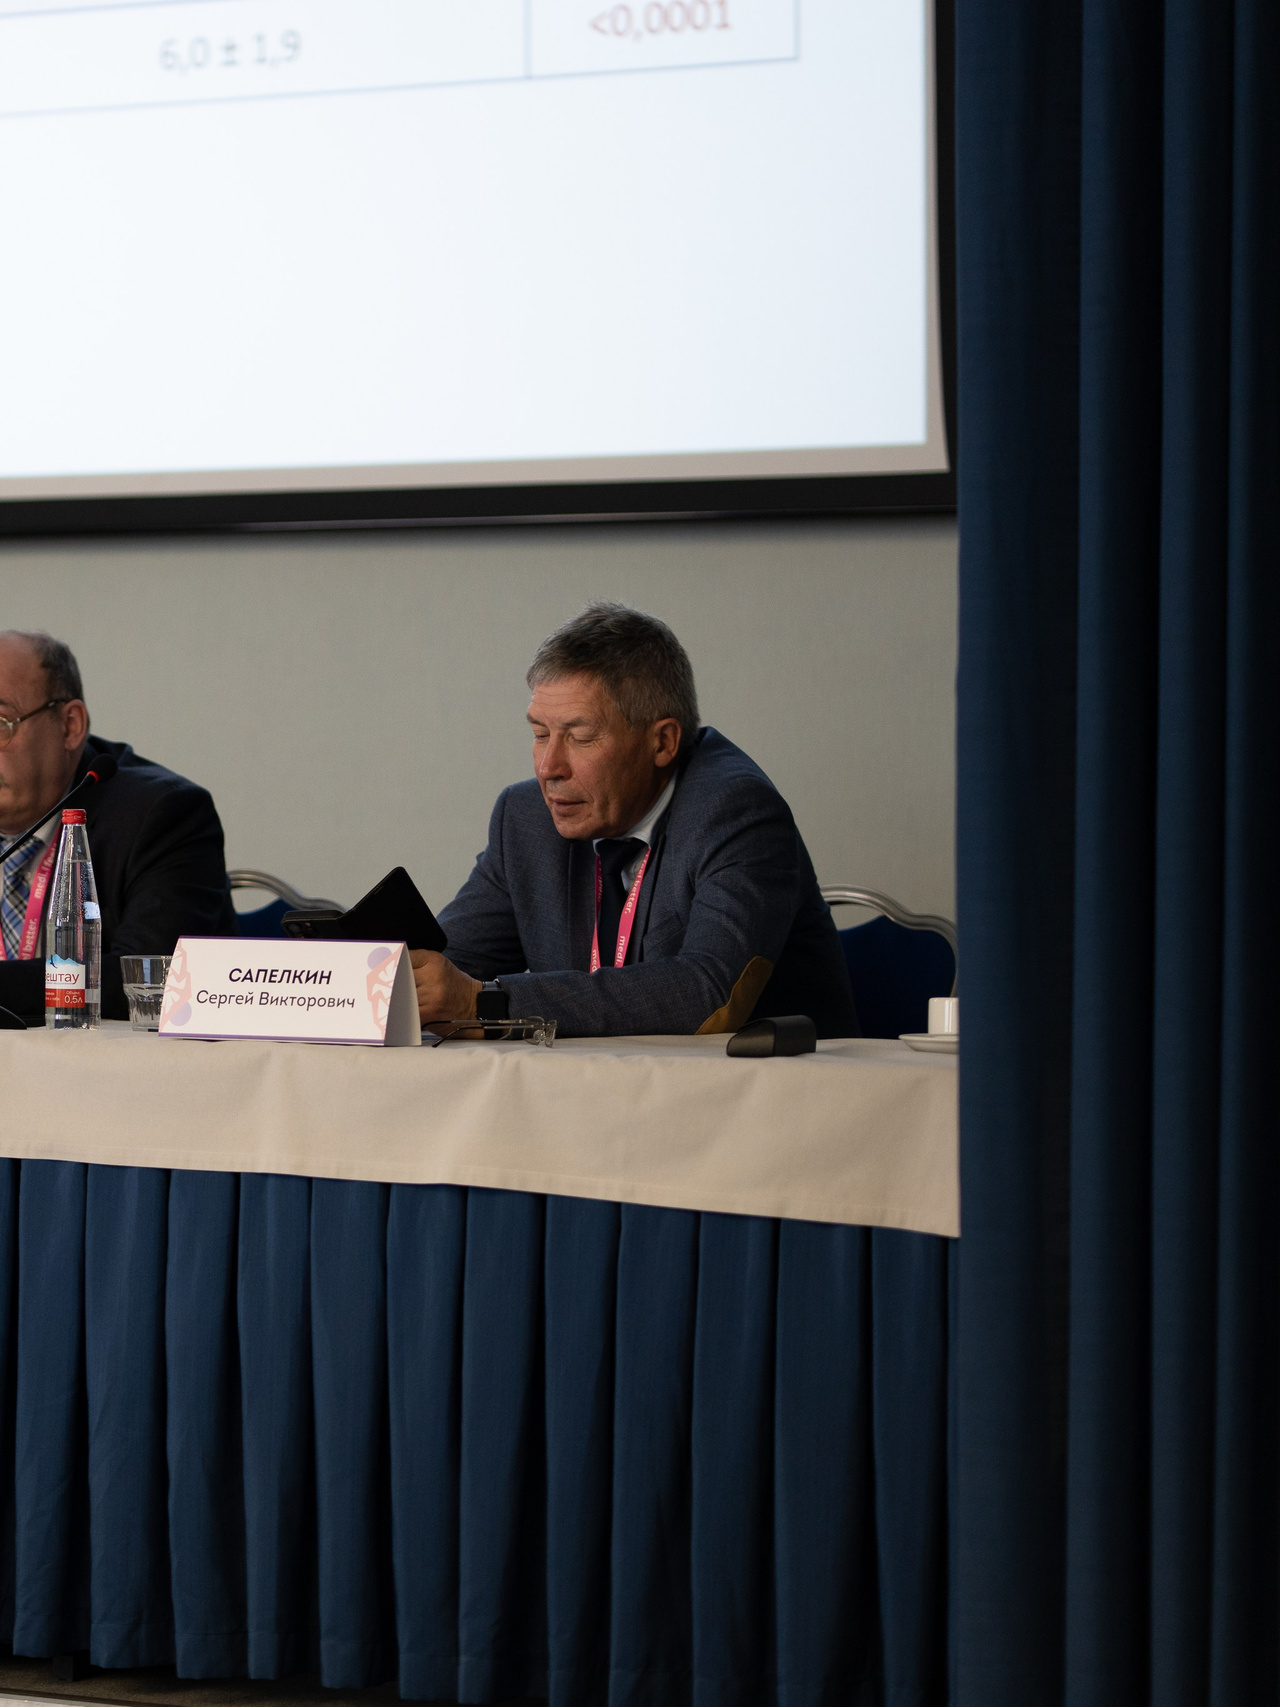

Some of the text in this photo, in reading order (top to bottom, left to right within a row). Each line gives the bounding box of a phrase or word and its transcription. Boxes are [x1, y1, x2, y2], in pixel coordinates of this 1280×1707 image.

[589, 0, 731, 42] <0,0001
[159, 36, 212, 76] 6,0
[252, 29, 301, 67] 1,9
[624, 880, 640, 914] better.
[615, 935, 626, 965] medi.
[228, 967, 332, 985] САПЕЛКИН
[196, 989, 356, 1011] Сергей Викторович
